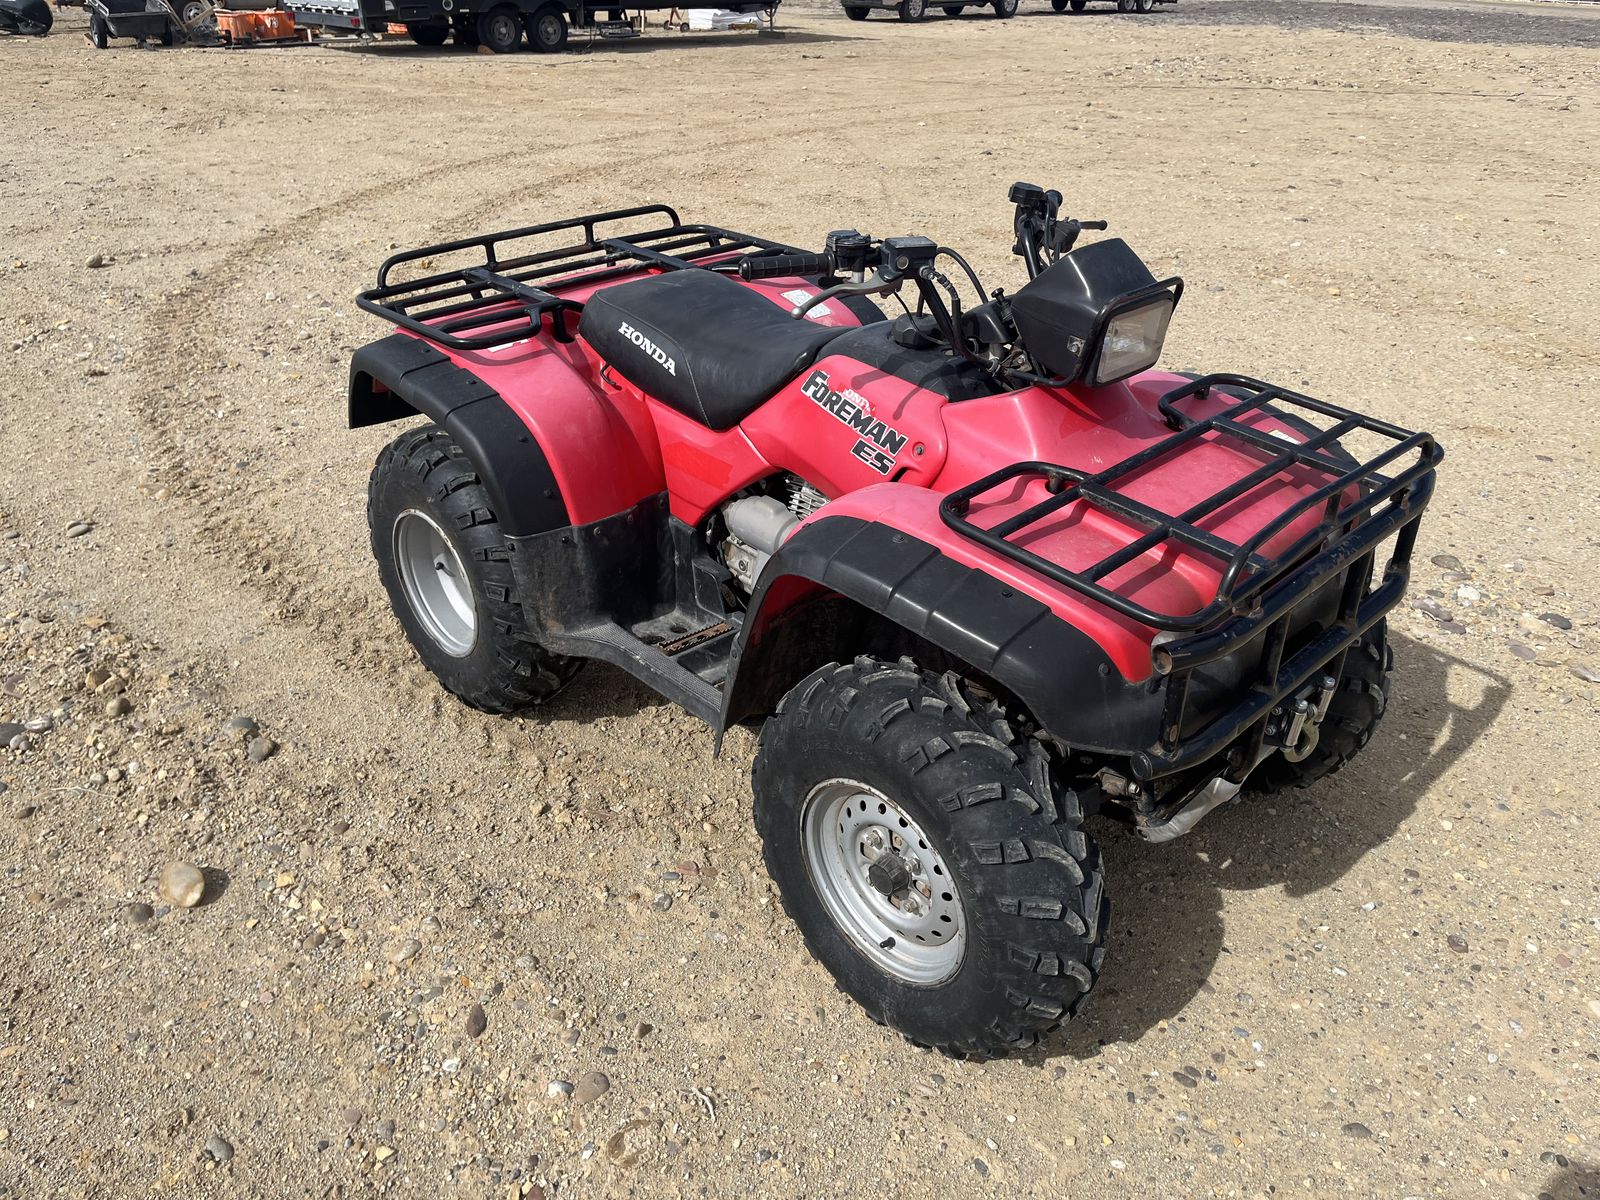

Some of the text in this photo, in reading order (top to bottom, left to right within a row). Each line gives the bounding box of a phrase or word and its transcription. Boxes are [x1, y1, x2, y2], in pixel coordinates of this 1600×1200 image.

[618, 321, 676, 376] HONDA
[801, 370, 908, 456] FOREMAN
[850, 438, 896, 475] ES
